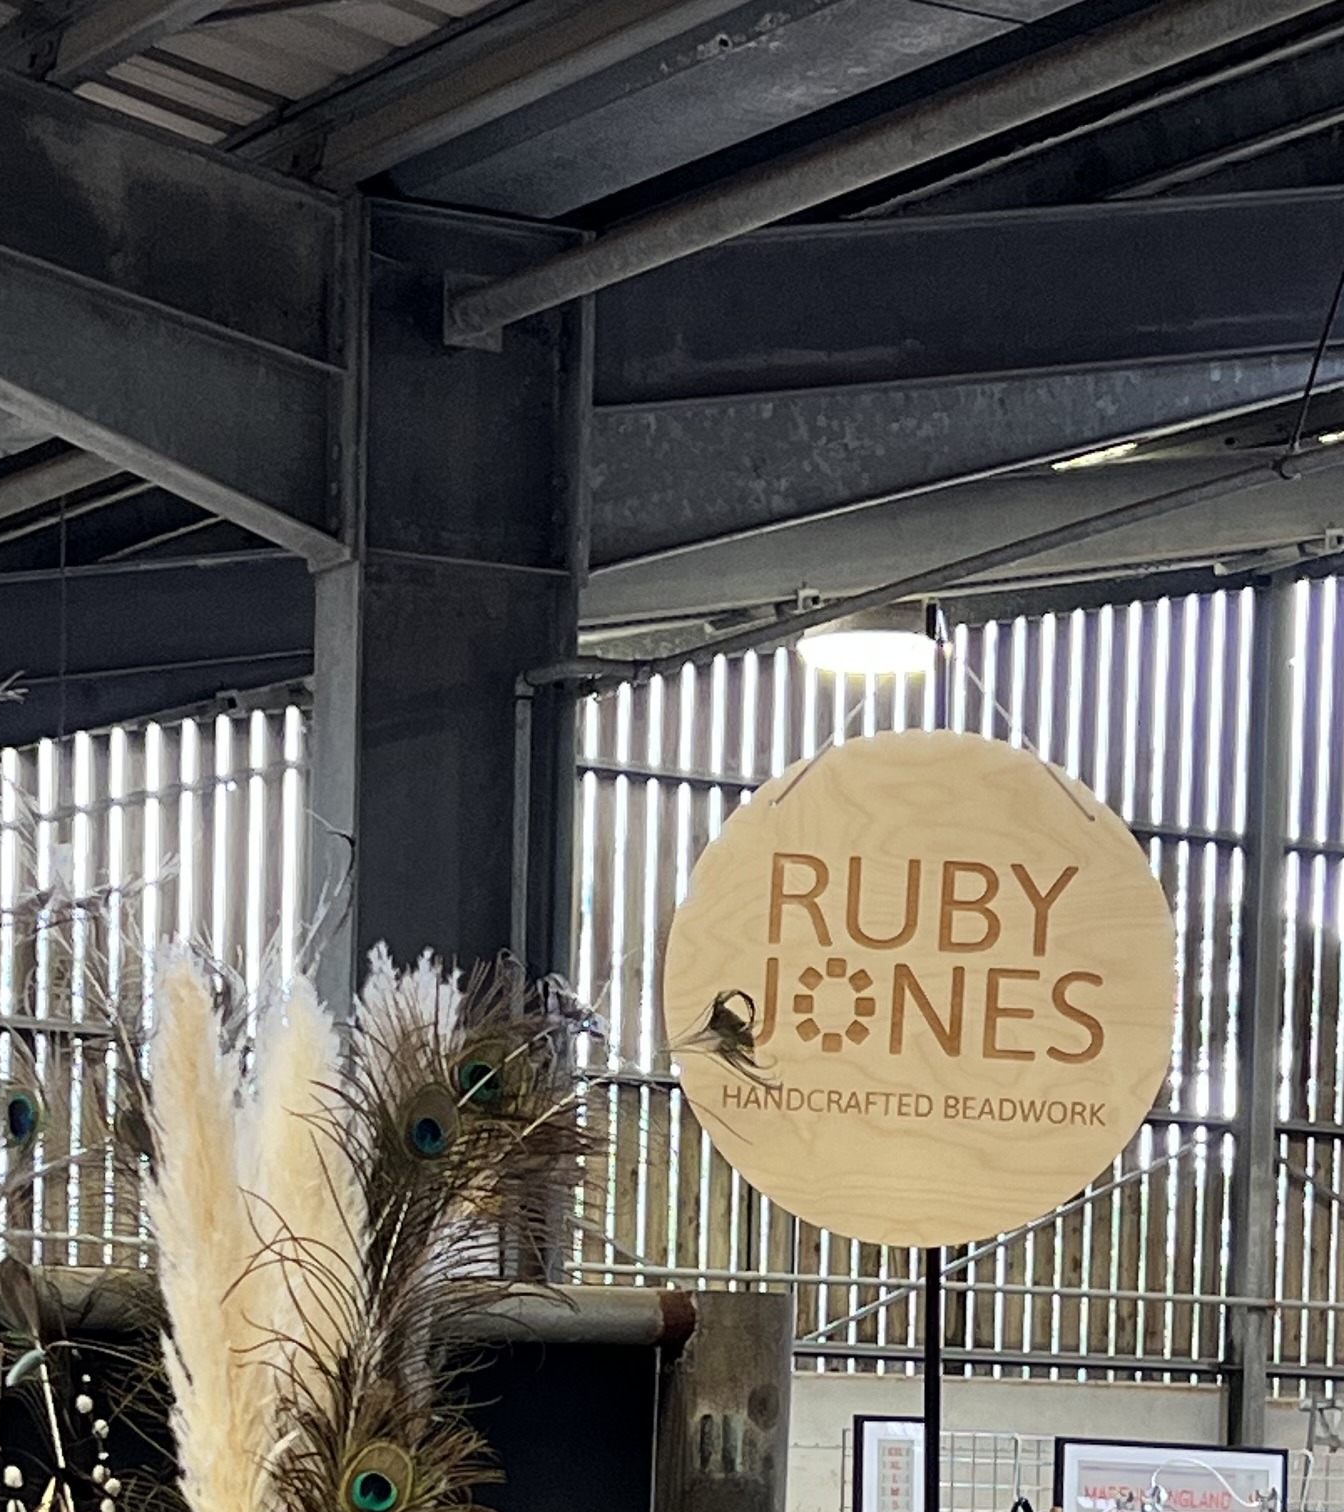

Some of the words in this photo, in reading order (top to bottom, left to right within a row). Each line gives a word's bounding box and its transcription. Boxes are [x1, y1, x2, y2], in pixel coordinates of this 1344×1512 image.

[767, 852, 1079, 957] RUBY
[754, 956, 1105, 1065] JONES
[721, 1084, 934, 1120] HANDCRAFTED
[943, 1095, 1107, 1128] BEADWORK
[1167, 1488, 1233, 1510] NGLAND
